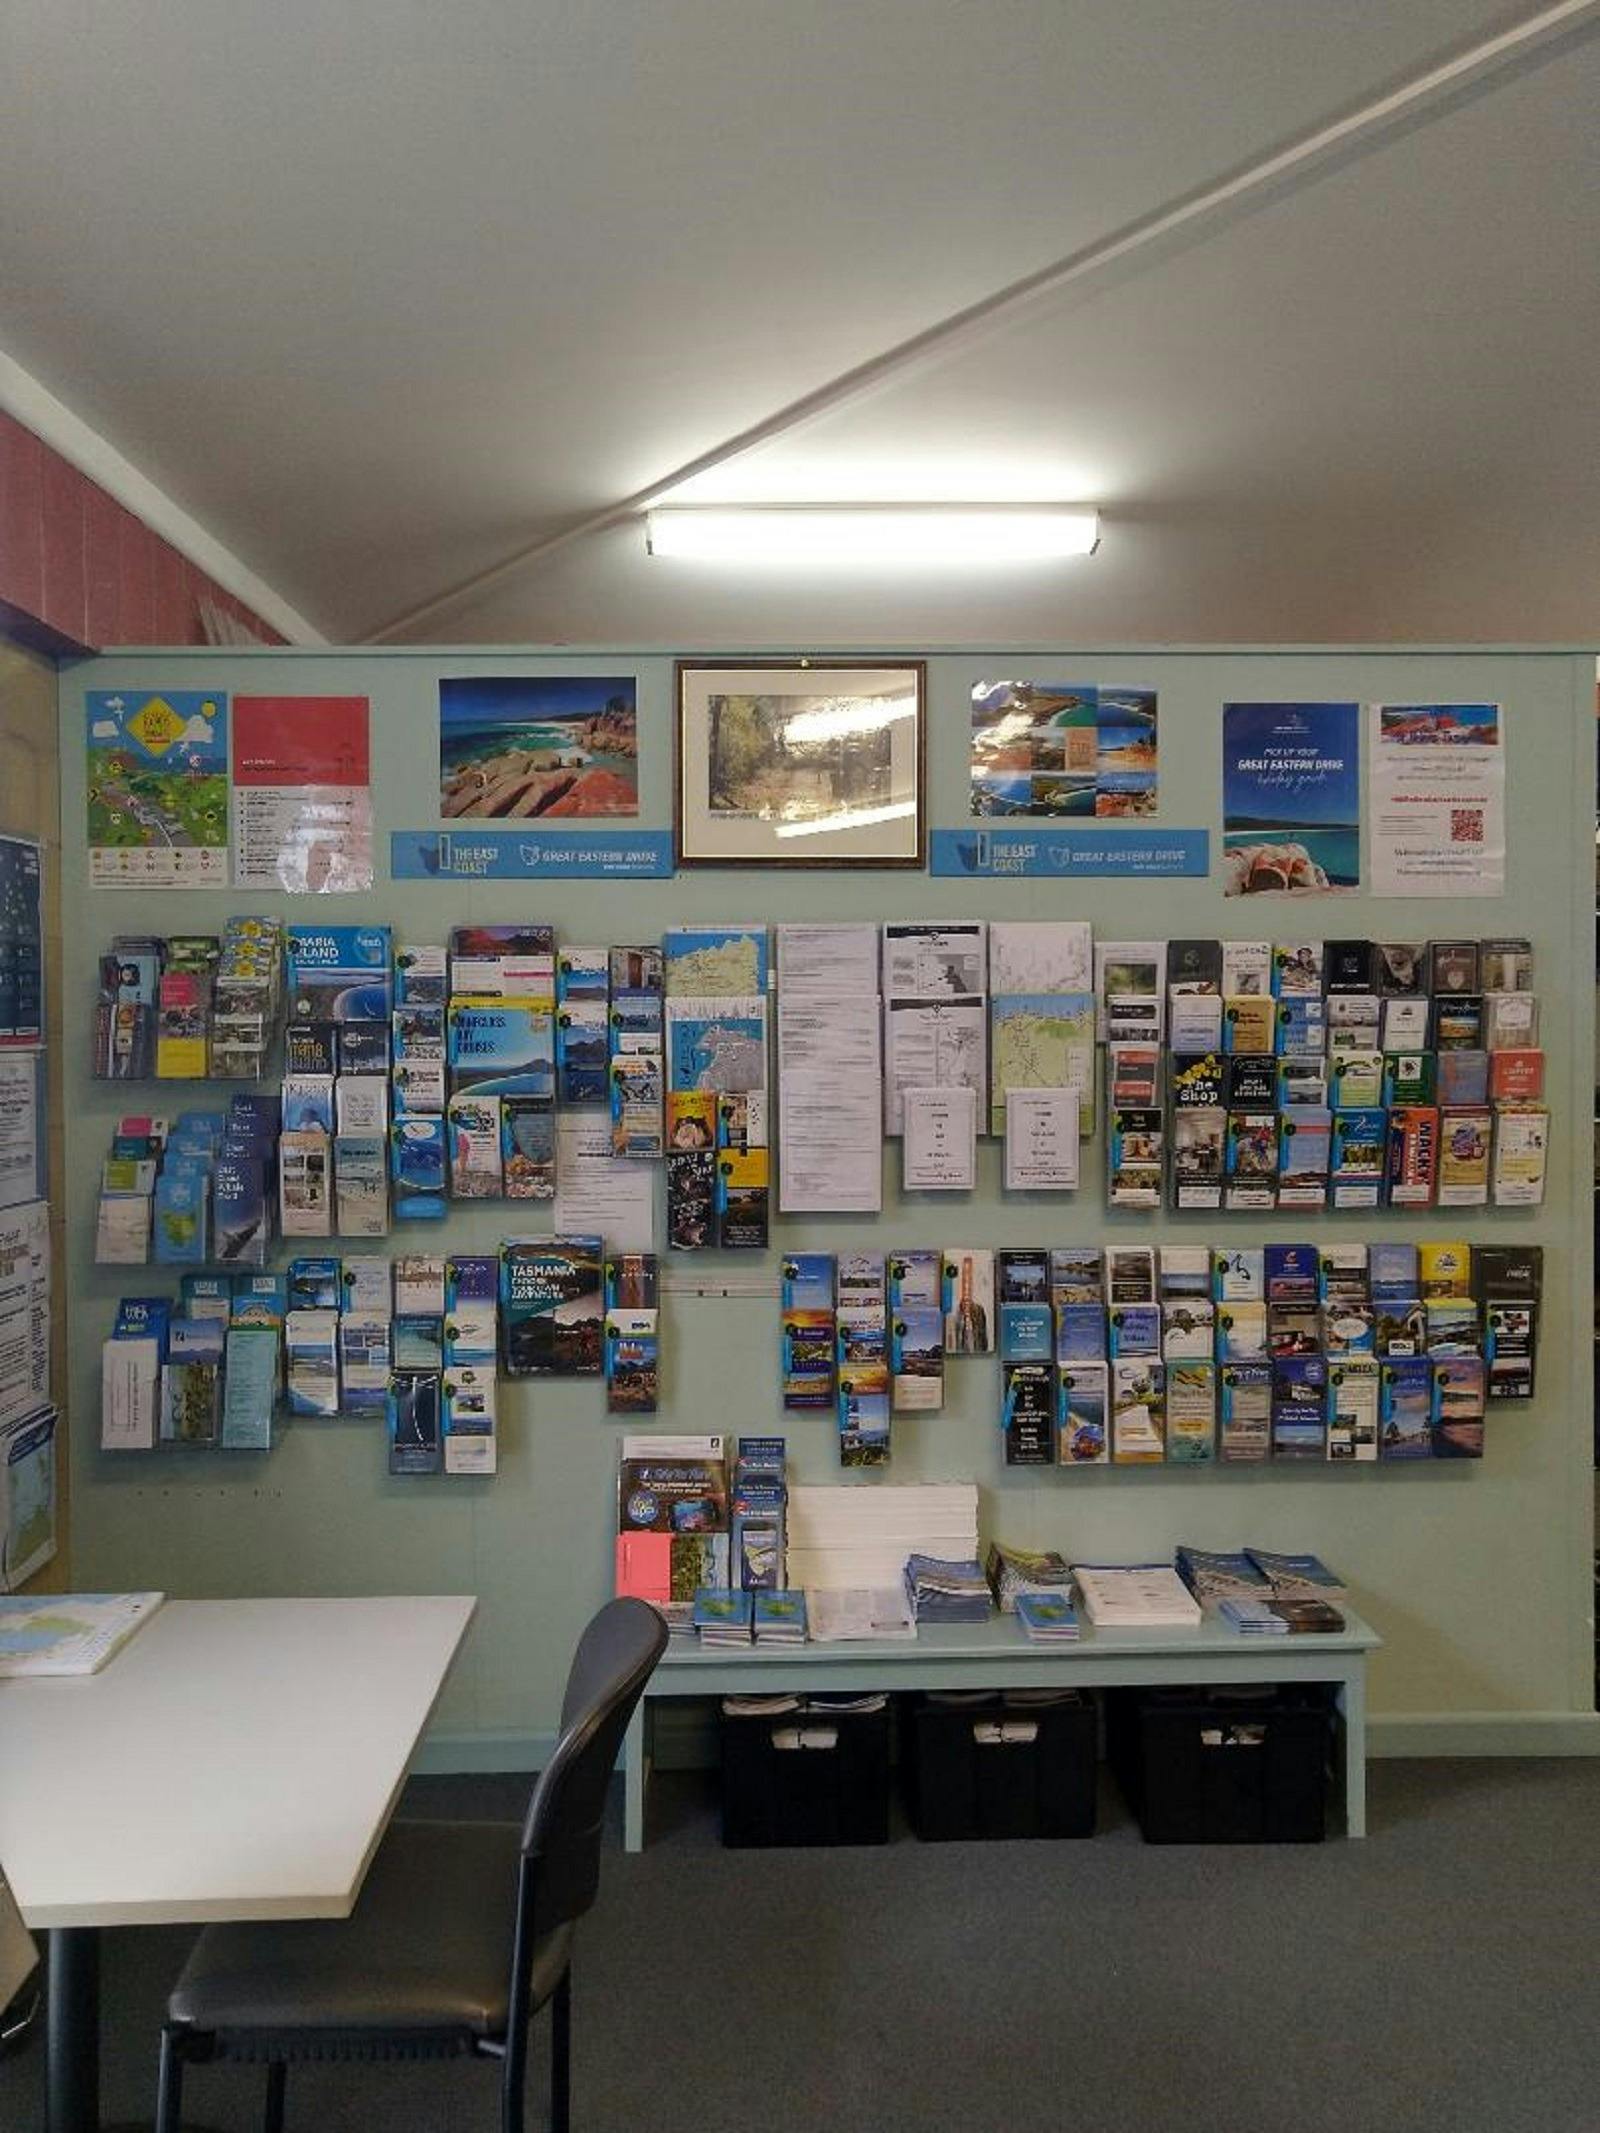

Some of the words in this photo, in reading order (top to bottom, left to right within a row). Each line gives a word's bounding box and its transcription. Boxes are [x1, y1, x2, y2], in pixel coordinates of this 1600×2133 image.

[1238, 759, 1269, 770] GREAT
[1270, 759, 1313, 770] EASTERN
[1315, 759, 1344, 770] DRIVE
[472, 847, 498, 860] EAST
[542, 851, 574, 863] GREAT
[578, 851, 622, 863] EASTERN
[625, 851, 659, 863] DRIVE
[1010, 844, 1037, 858] EAST
[1072, 851, 1104, 863] GREAT
[1107, 851, 1153, 863] EASTERN
[1155, 850, 1186, 863] DRIVE
[453, 861, 488, 874] COAST
[993, 858, 1026, 873] COAST
[297, 936, 335, 947] MARIA
[1180, 1089, 1218, 1102] Shop
[511, 1265, 576, 1277] TASMANIA
